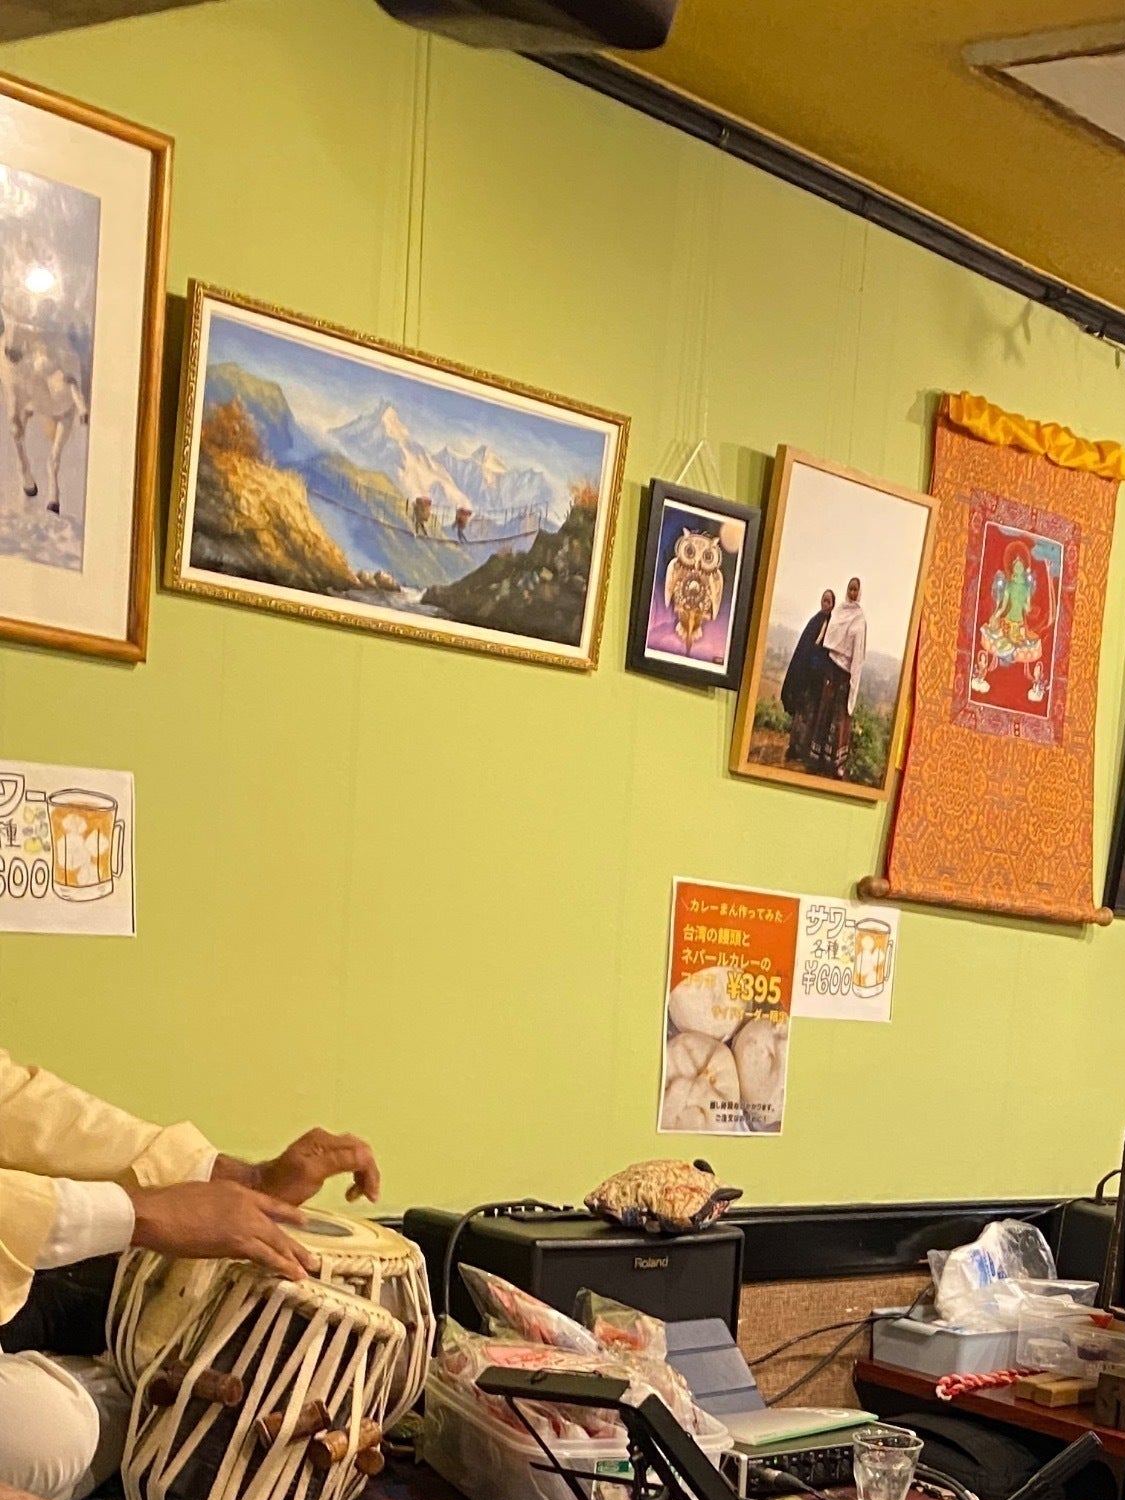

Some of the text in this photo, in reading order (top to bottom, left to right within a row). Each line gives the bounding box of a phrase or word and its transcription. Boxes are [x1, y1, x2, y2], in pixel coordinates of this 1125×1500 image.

[0, 855, 50, 898] 00
[690, 898, 784, 924] カレーまん作ってみた
[806, 904, 855, 938] サワー
[683, 924, 751, 947] 台湾の饅頭と
[681, 947, 772, 972] ネパールカレーの
[811, 940, 840, 960] 各種
[726, 969, 783, 1005] ¥395
[802, 961, 852, 996] ¥600
[634, 1255, 669, 1270] Roland
